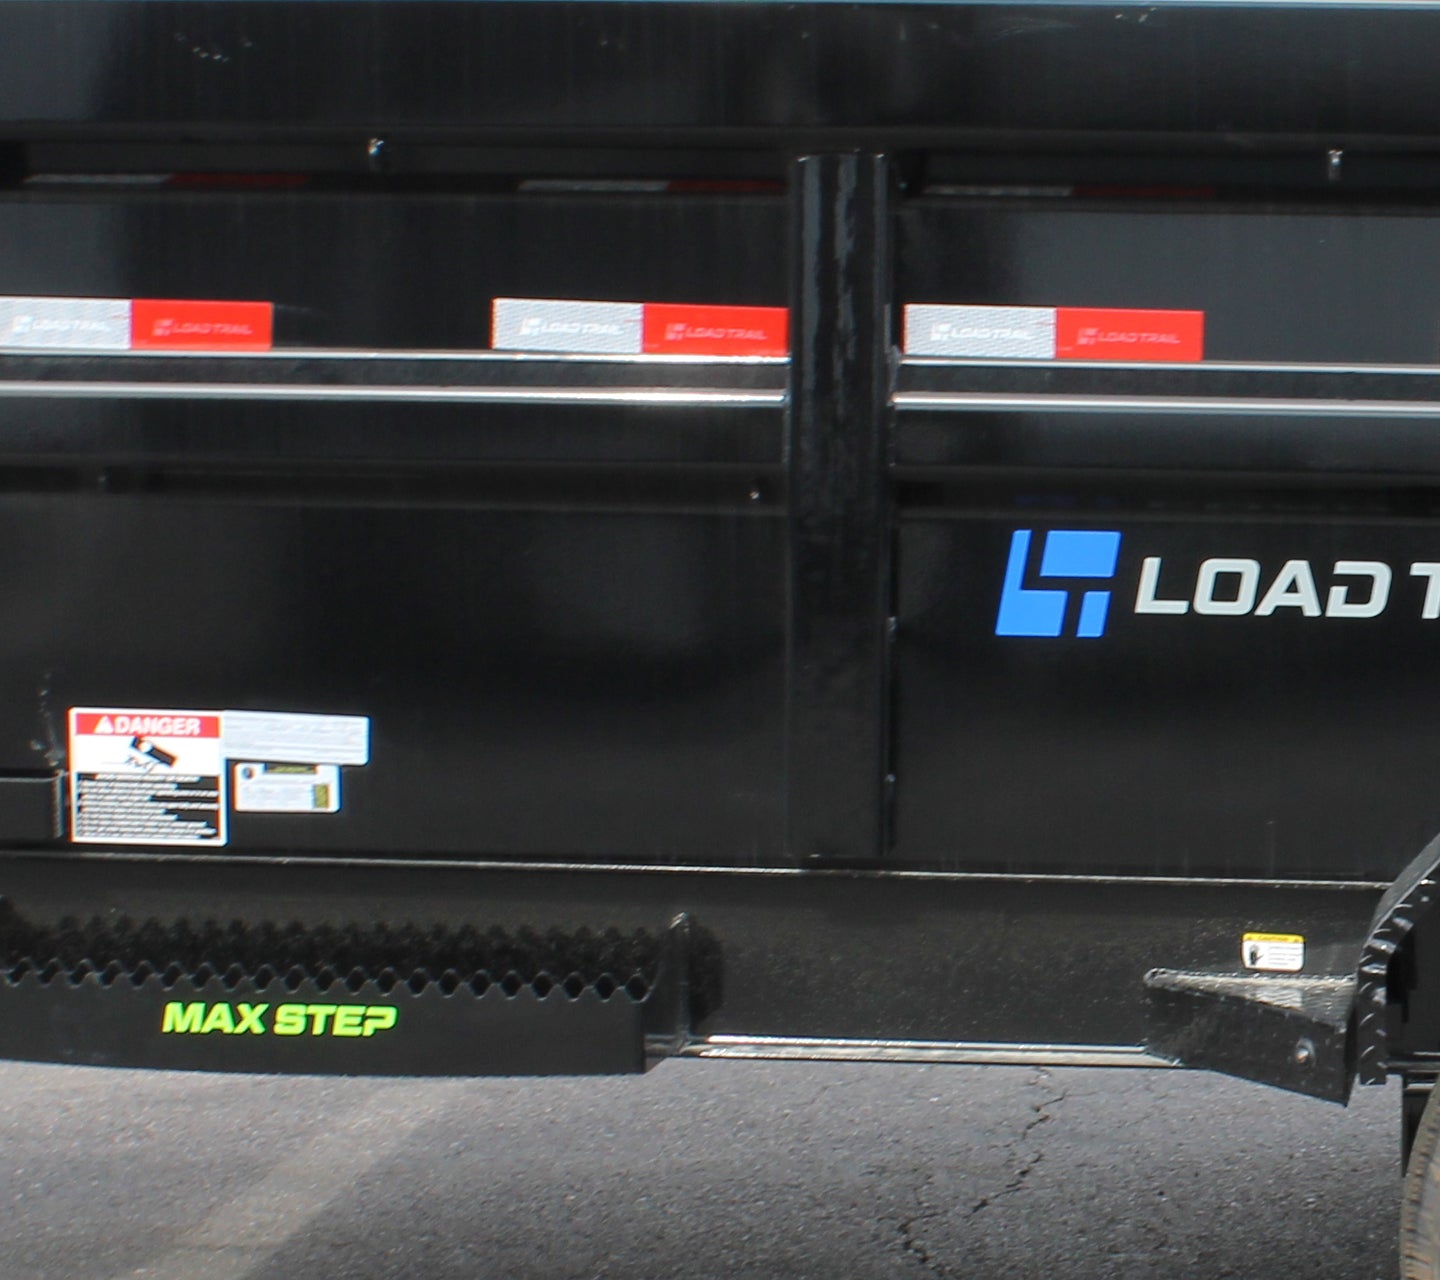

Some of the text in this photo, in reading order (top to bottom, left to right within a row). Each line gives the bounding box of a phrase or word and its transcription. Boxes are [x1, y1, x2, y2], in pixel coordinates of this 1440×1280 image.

[1134, 556, 1392, 618] LOAD
[114, 716, 201, 736] DANGER
[162, 1002, 399, 1038] MAX STEP
